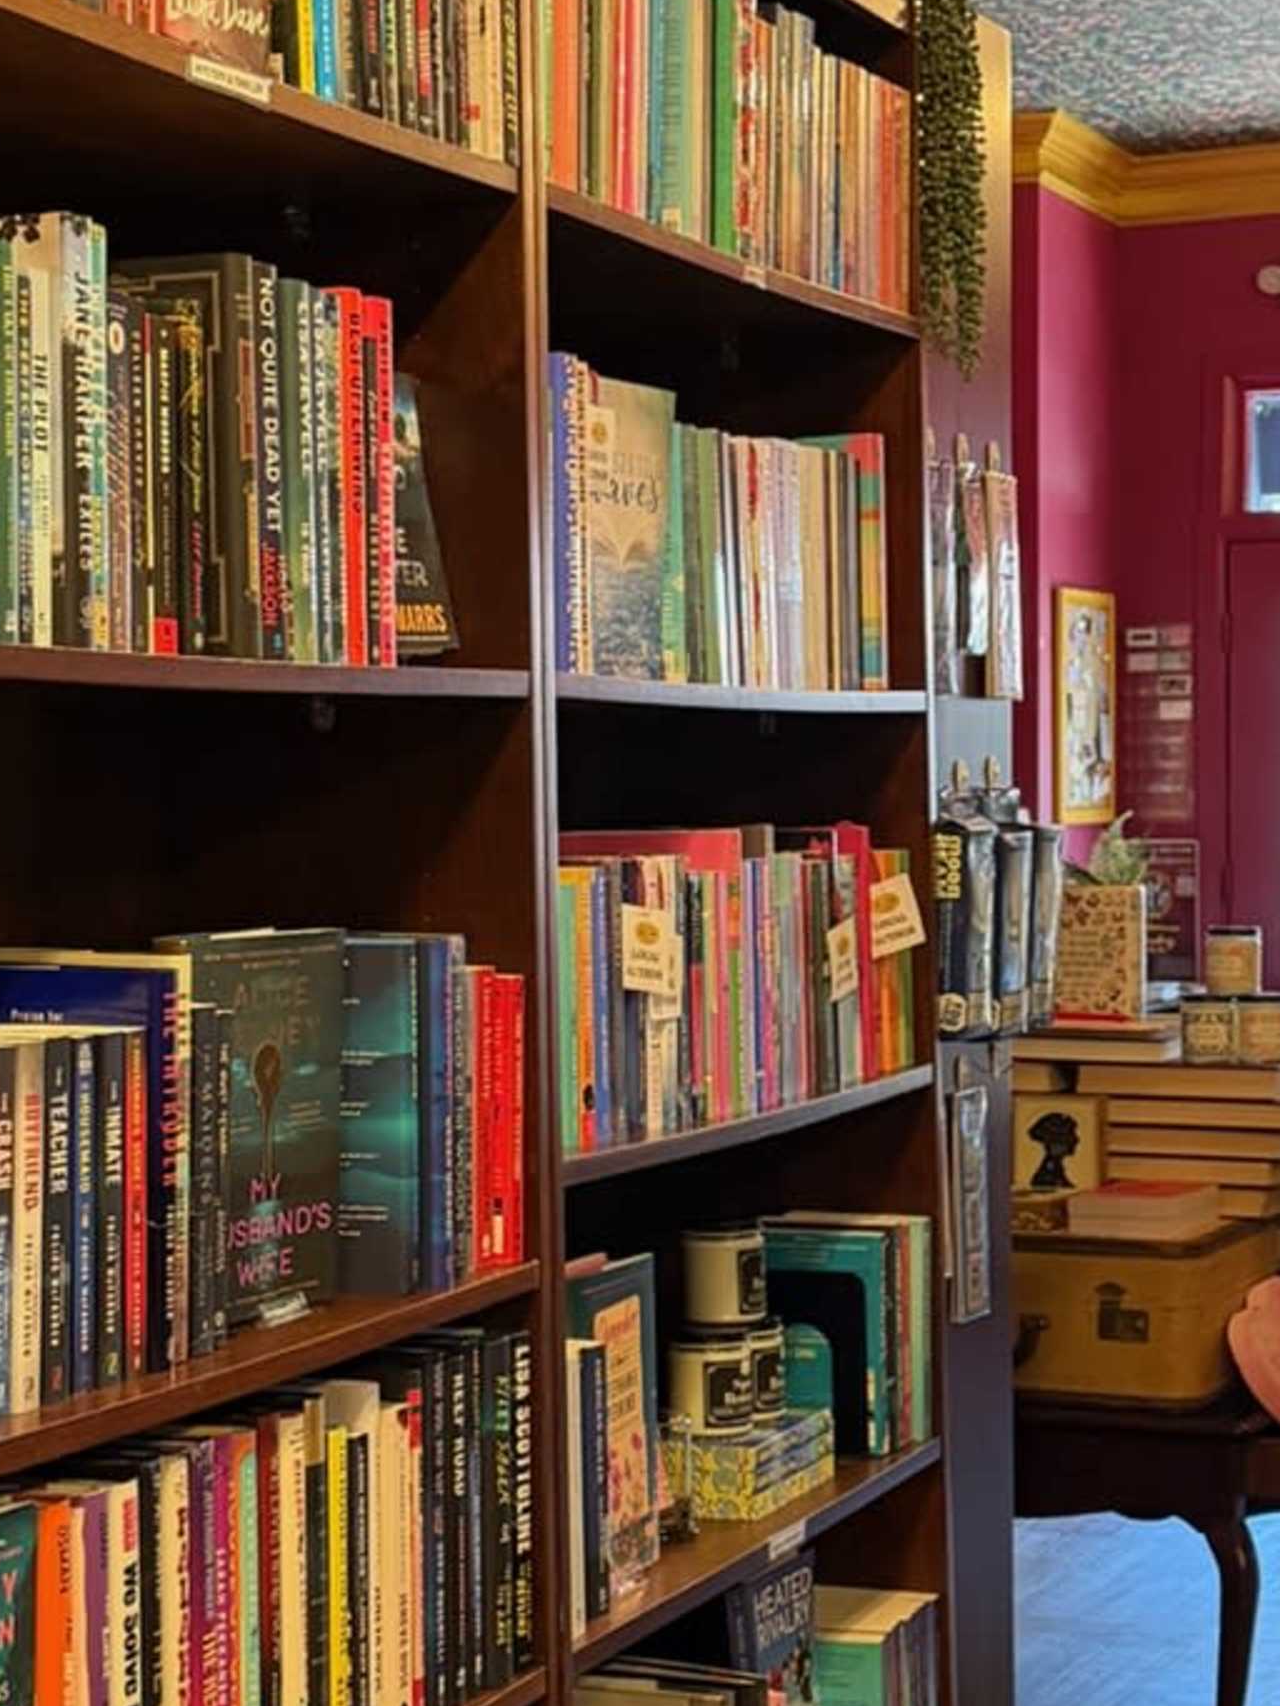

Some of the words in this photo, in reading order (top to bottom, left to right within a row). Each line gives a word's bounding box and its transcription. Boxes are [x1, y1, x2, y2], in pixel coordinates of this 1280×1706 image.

[74, 270, 91, 347] JANE
[259, 277, 275, 328] NOT
[33, 352, 48, 392] THE
[260, 335, 278, 409] QUITE
[34, 399, 49, 454] PLOT
[75, 354, 92, 471] HARPER
[262, 417, 281, 482] DEAD
[76, 493, 91, 571] EXILES
[264, 493, 283, 533] YET
[23, 1092, 41, 1213] BOYFRIEND
[48, 1095, 68, 1195] TEACHER
[104, 1106, 121, 1185] INMATE
[248, 1172, 281, 1201] MY
[236, 1245, 295, 1288] WIFE
[513, 1346, 531, 1400] LISA
[514, 1406, 533, 1556] SCOTTOLINE
[121, 1561, 139, 1606] We
[753, 1568, 813, 1614] HEATED
[755, 1600, 812, 1648] RIVALRY
[122, 1615, 140, 1697] Solve
